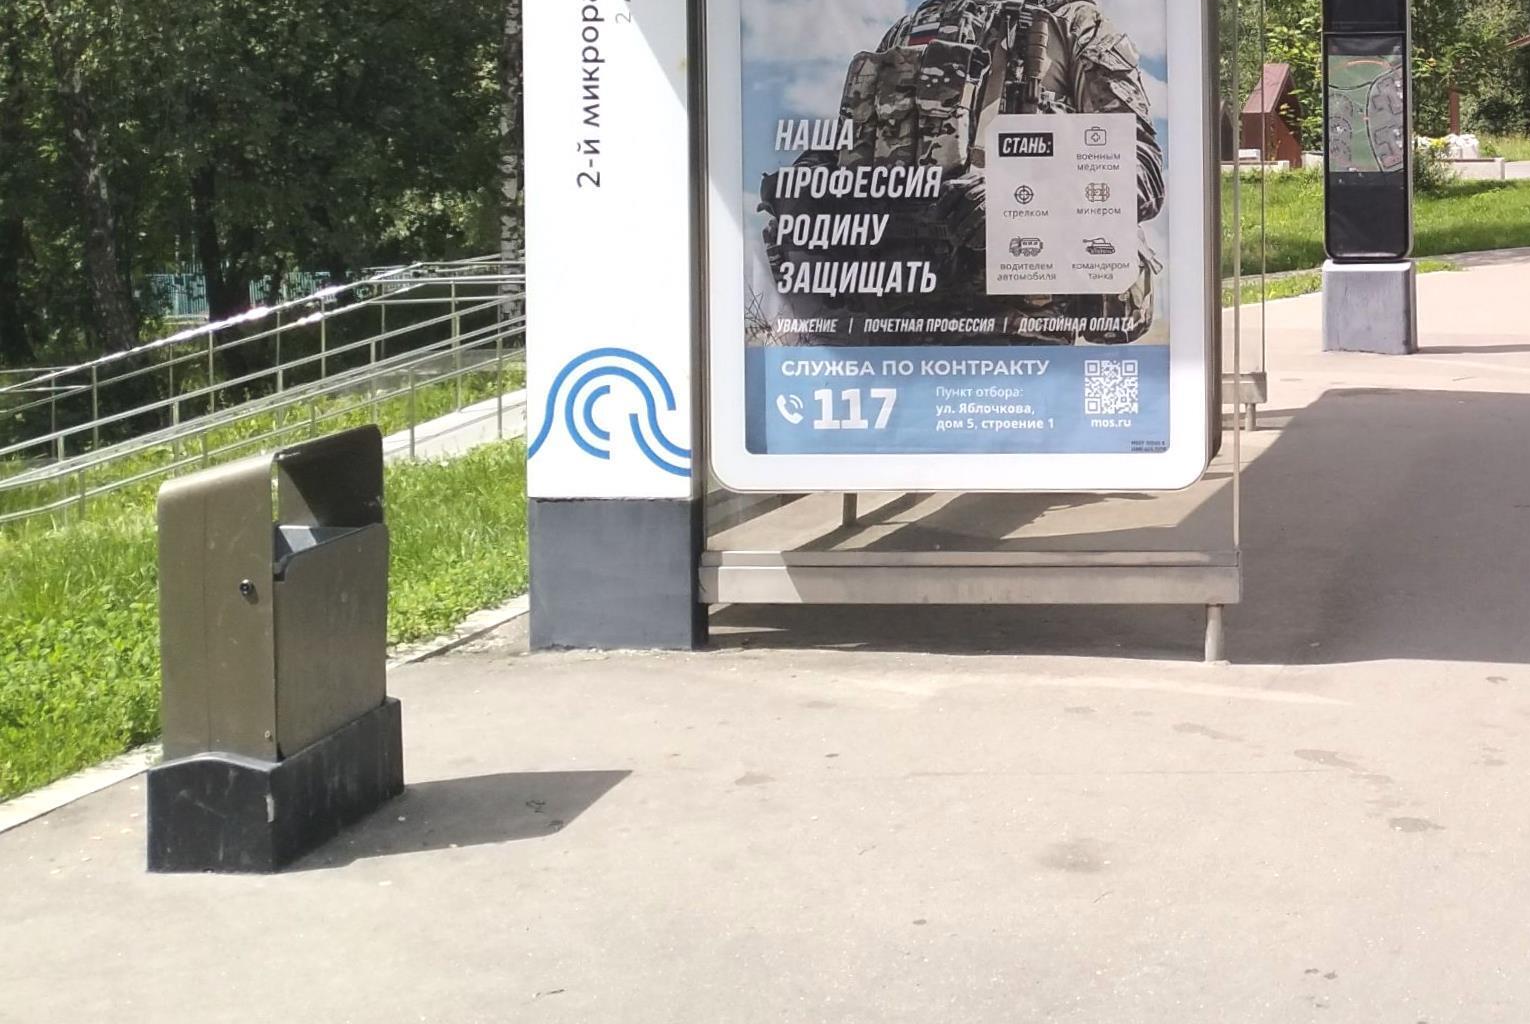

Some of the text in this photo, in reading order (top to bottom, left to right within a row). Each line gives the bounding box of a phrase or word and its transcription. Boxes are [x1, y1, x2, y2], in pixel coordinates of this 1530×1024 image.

[615, 12, 631, 24] 2
[774, 118, 854, 151] НАША
[1002, 136, 1052, 155] СТАНЬ:
[576, 139, 601, 188] 2-й
[775, 166, 943, 198] ПРОФЕССИЯ
[1003, 209, 1049, 218] стрелком
[1076, 207, 1121, 216] минером
[776, 214, 890, 250] РОДИНУ
[1000, 262, 1053, 271] водителем
[1072, 262, 1130, 270] командиром
[777, 261, 937, 297] ЗАЩИЩАТЬ
[997, 272, 1057, 281] автомобиля
[776, 314, 1135, 333] УВАЖЕНИЕ ПОЧЕТНАЯ ПРОФЕССИЯ ДОСТОЙНАЯ ОПЛАТА
[781, 359, 1051, 376] СЛУЖБА ПО КОНТРАКТУ
[936, 385, 1024, 399] Пункт отбора:
[813, 388, 897, 430] 117
[935, 402, 1036, 416] ул. Яблочкова,
[936, 420, 963, 431] дом
[981, 420, 1044, 431] строение
[1048, 418, 1054, 429] 1
[1090, 418, 1132, 428] mos.ru
